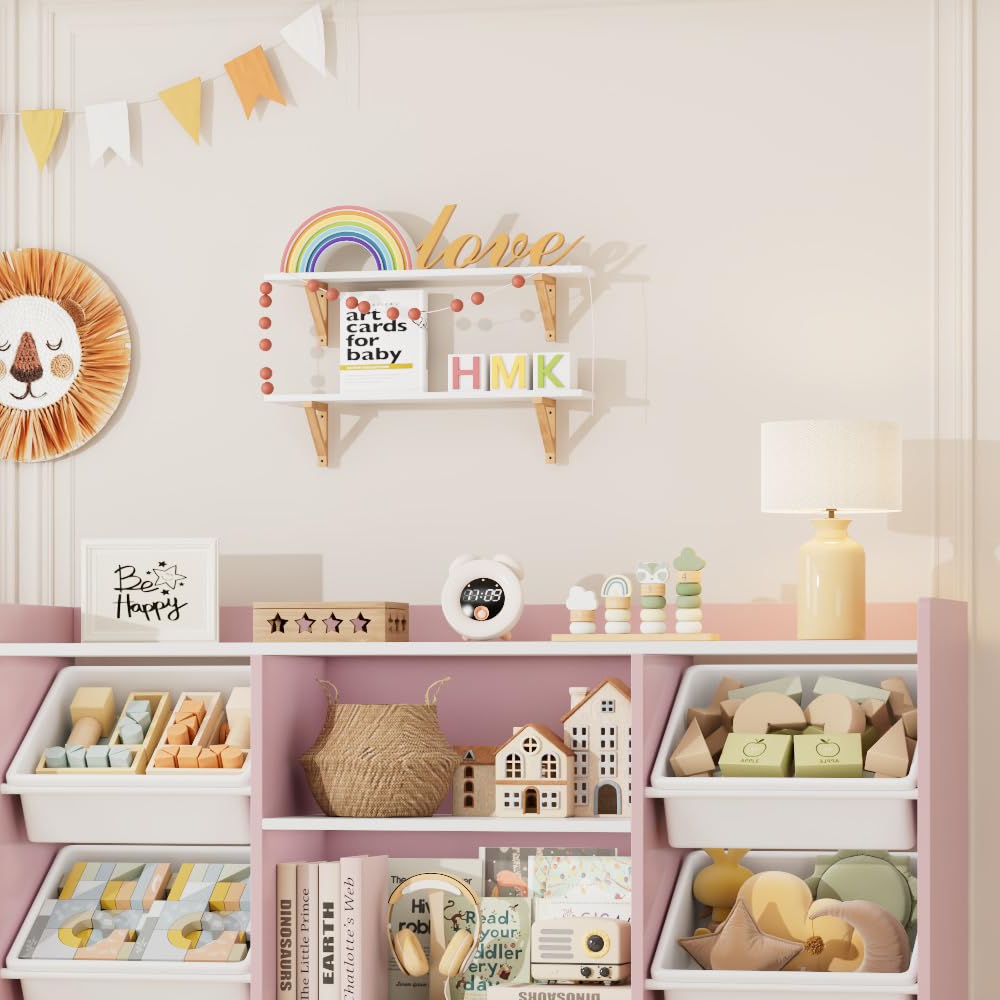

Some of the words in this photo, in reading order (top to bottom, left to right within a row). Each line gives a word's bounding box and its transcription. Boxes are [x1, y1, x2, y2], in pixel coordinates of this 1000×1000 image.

[416, 204, 585, 269] love
[346, 309, 381, 321] art
[346, 320, 407, 333] cards
[345, 334, 380, 347] for
[346, 347, 402, 364] baby
[114, 564, 159, 593] Be
[112, 593, 188, 621] Happy
[343, 877, 355, 912] Web
[300, 888, 310, 932] Prince
[280, 899, 292, 992] DINOSAURS
[322, 901, 335, 985] EARTH
[480, 928, 518, 942] your
[300, 936, 310, 973] Little
[474, 943, 522, 959] ddler
[468, 962, 498, 977] ery
